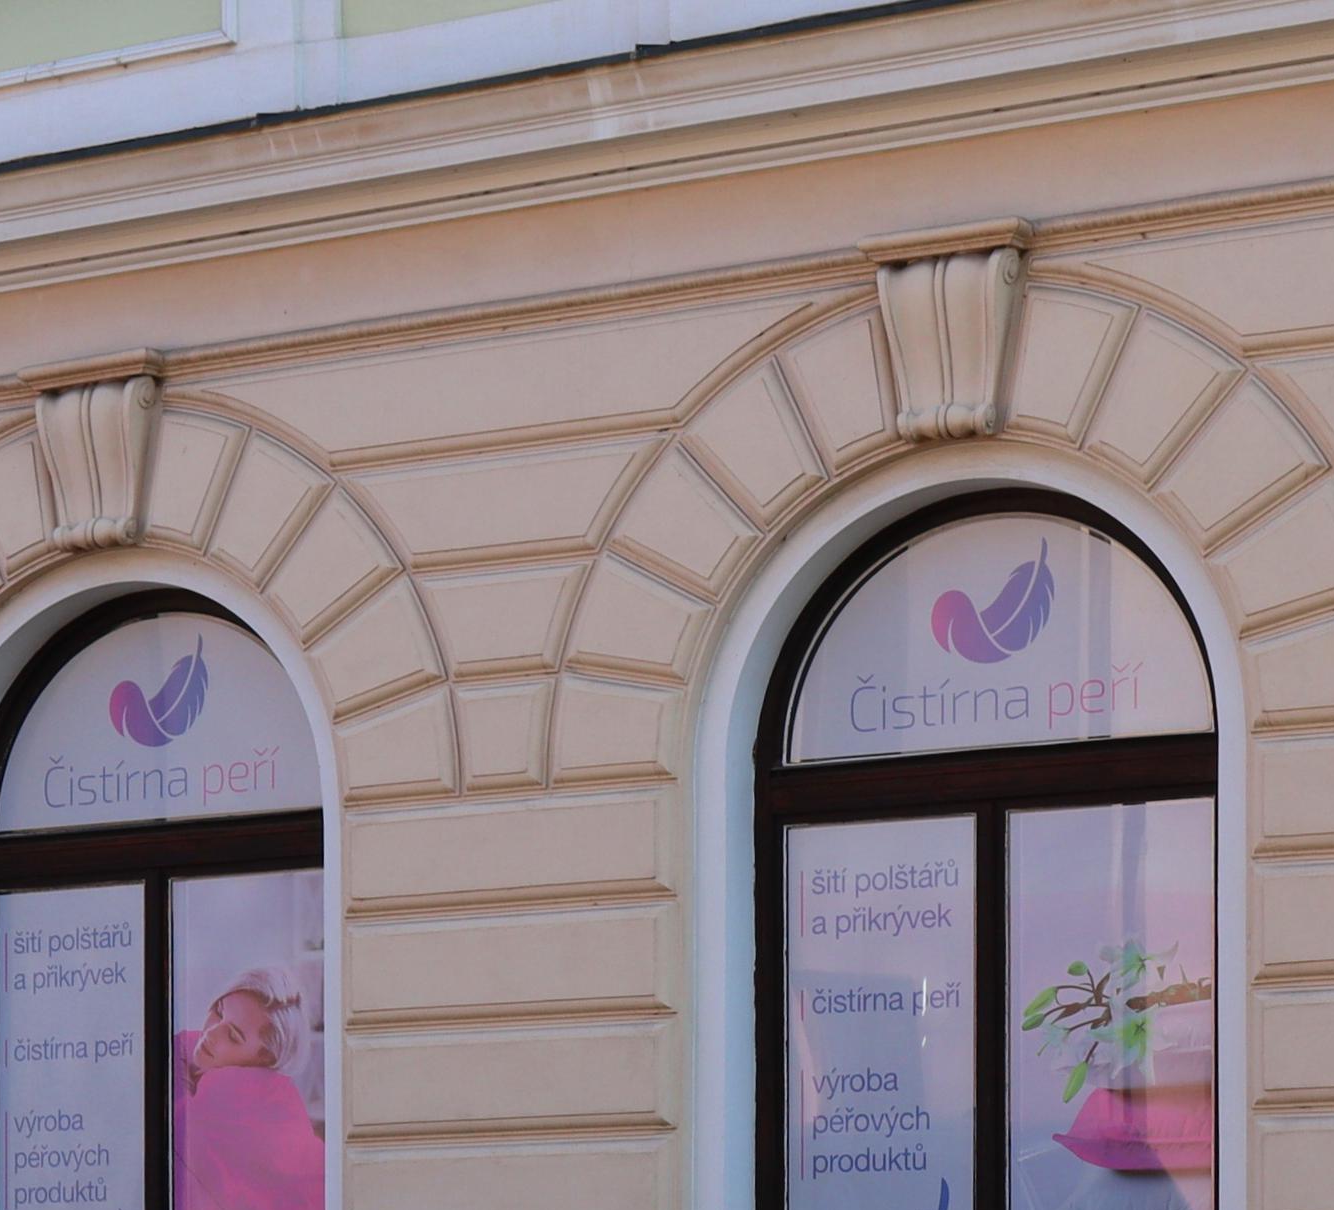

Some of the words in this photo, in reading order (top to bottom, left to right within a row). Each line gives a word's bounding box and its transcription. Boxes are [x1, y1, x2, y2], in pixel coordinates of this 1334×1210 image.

[850, 674, 1029, 733] Čistírna
[1048, 661, 1144, 729] peří
[43, 755, 188, 808] Čistírna
[202, 746, 280, 806] peří
[811, 868, 848, 895] šití
[855, 859, 959, 898] polštářů
[811, 916, 827, 935] a
[835, 903, 953, 939] přikrývek
[13, 930, 42, 954] šití
[48, 922, 133, 957] polštářů
[13, 975, 27, 991] a
[33, 963, 128, 995] přikrývek
[811, 988, 904, 1016] čistírna
[912, 982, 962, 1016] peří
[13, 1036, 88, 1063] čistírna
[94, 1032, 134, 1064] peří
[811, 1068, 899, 1100] výroba
[13, 1109, 85, 1139] výroba
[812, 1105, 931, 1140] péřových
[14, 1144, 110, 1174] péřových
[812, 1144, 928, 1180] produktů
[14, 1177, 107, 1210] produktů
